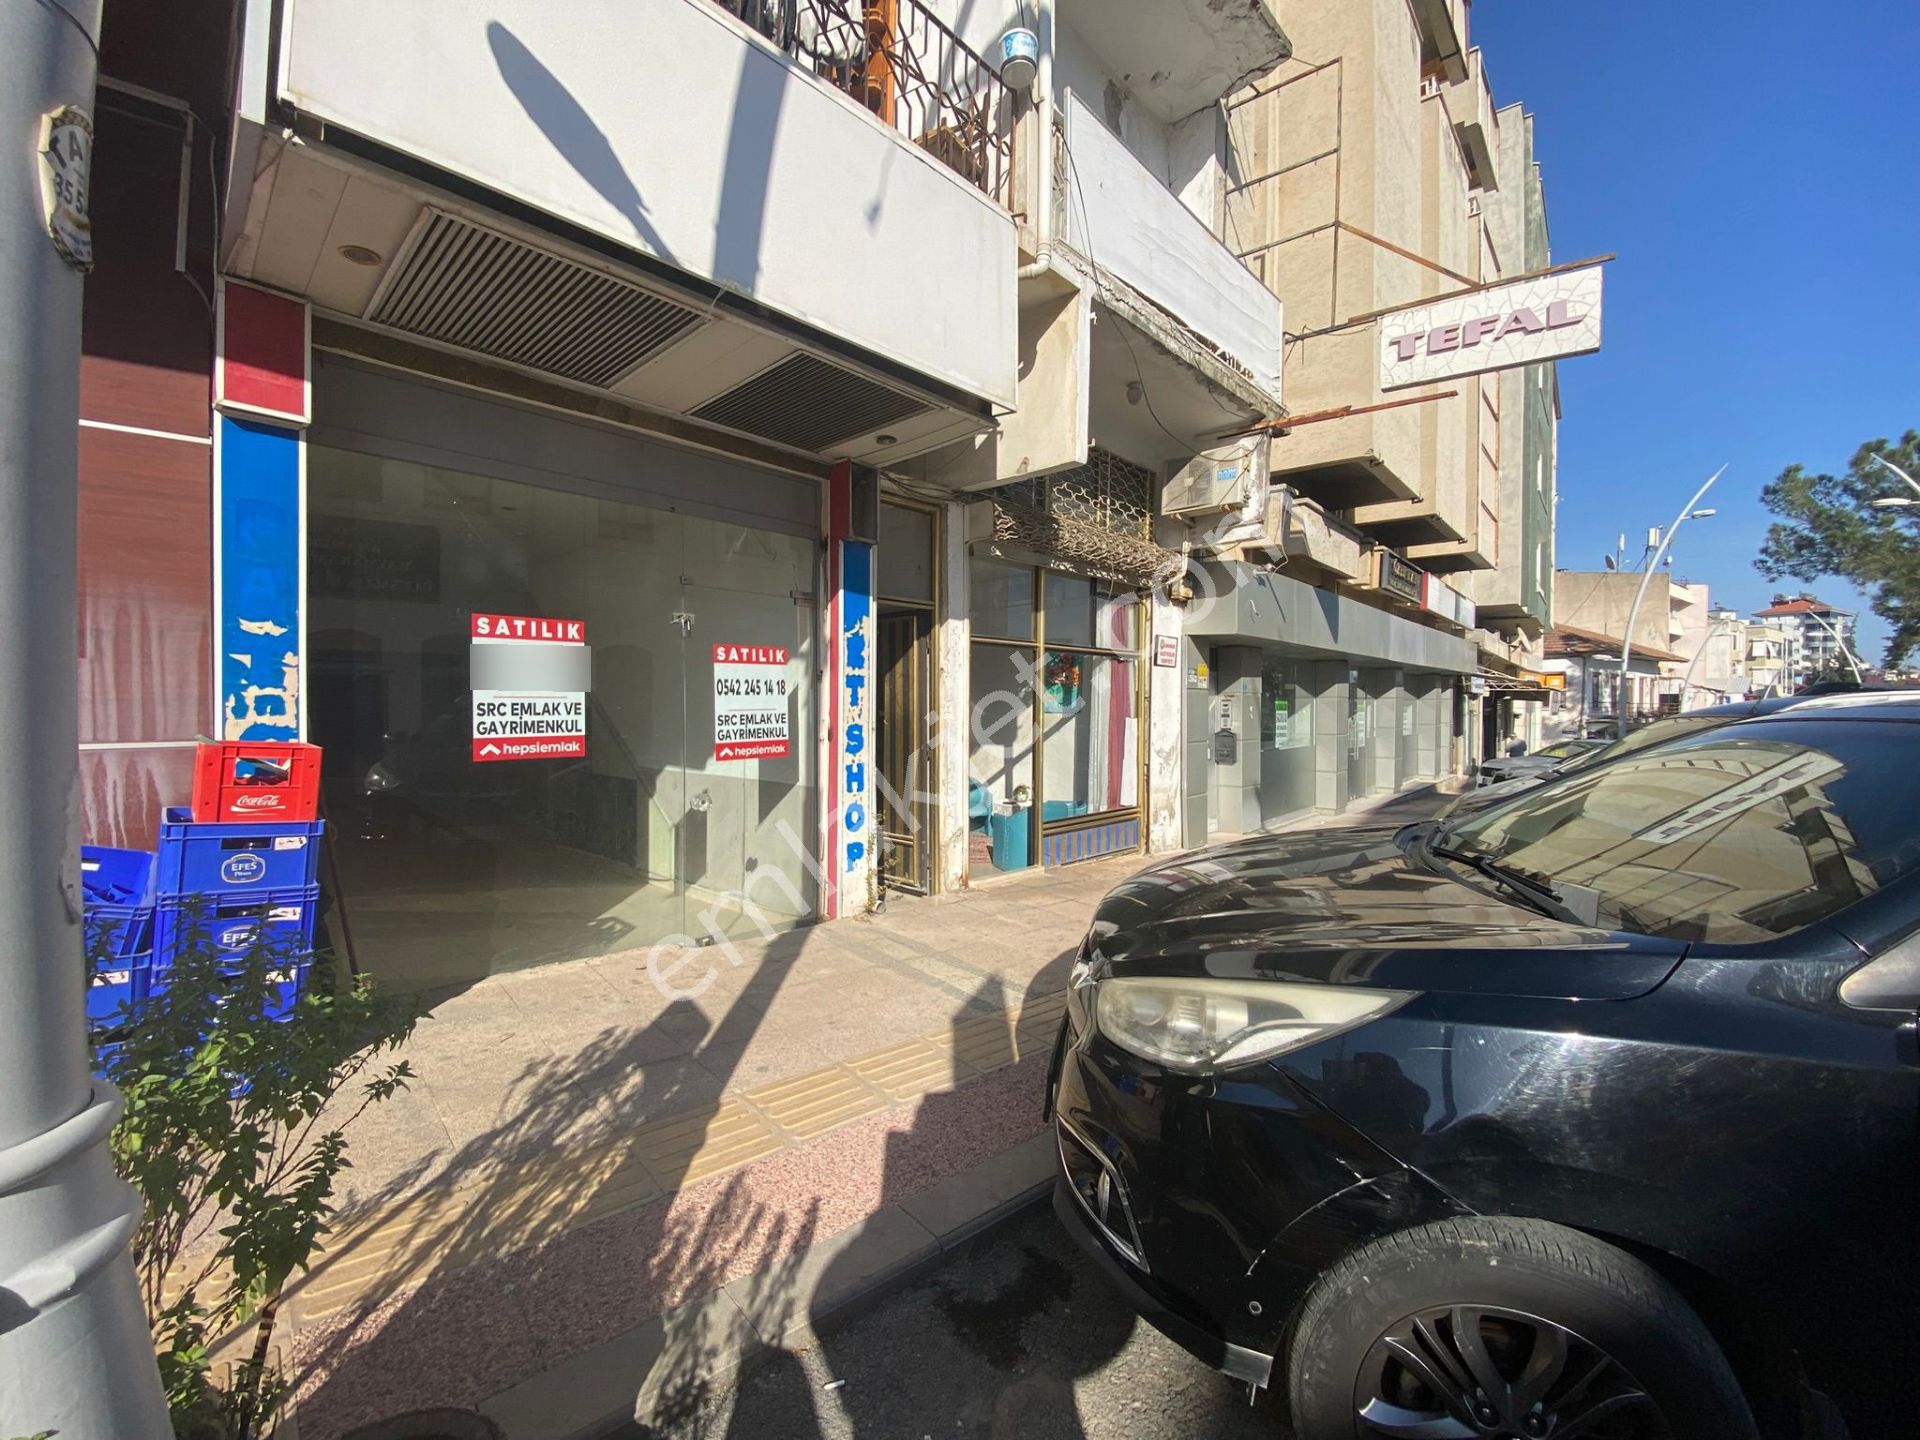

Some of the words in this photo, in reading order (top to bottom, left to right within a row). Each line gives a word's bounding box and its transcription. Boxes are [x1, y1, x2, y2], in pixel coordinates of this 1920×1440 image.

[1388, 299, 1588, 362] TEFAL
[477, 617, 580, 640] SATILIK
[717, 647, 785, 662] SATILIK
[716, 679, 741, 696] 0542
[744, 679, 761, 696] 245
[764, 679, 774, 696] 14
[776, 679, 786, 696] 18
[476, 702, 507, 717] SRC
[511, 702, 561, 717] EMLAK
[564, 702, 582, 715] VE
[476, 717, 582, 735] GAYRİMENKUL
[717, 714, 738, 726] SRC
[740, 713, 773, 726] EMLAK
[774, 713, 786, 724] VE
[717, 726, 787, 741] GAYRİMENKUL
[503, 741, 580, 755] hepsiemlak
[735, 744, 785, 757] hepsiemlak
[231, 862, 257, 871] EFES
